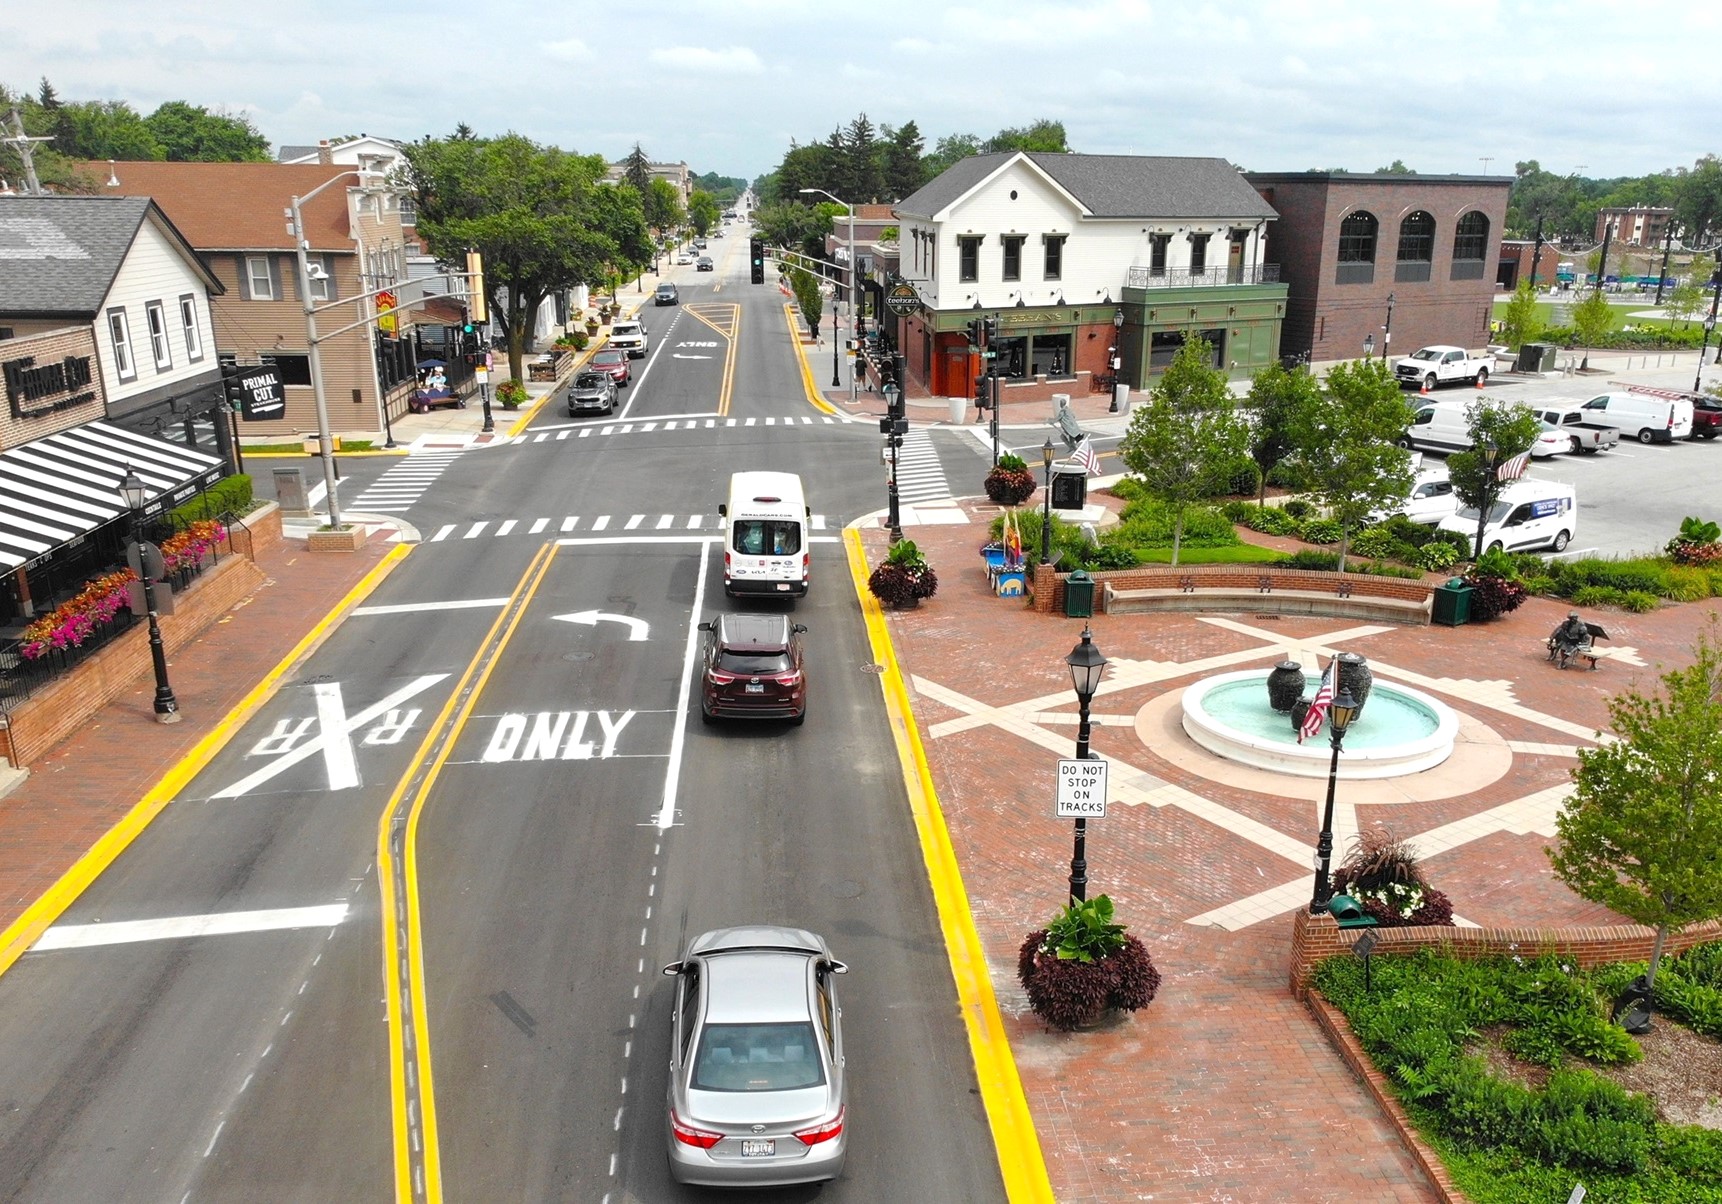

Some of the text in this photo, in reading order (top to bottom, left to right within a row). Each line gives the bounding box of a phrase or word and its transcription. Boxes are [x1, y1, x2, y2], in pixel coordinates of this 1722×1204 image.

[63, 355, 92, 392] CUT
[242, 373, 278, 391] PRIMAL
[253, 386, 274, 402] CUT
[25, 552, 53, 572] TEAKS COPS
[482, 710, 637, 763] ONLY
[1062, 766, 1103, 776] DO NOT
[1068, 778, 1097, 788] STOP
[1073, 790, 1090, 800] ON
[1060, 802, 1103, 812] TRACKS
